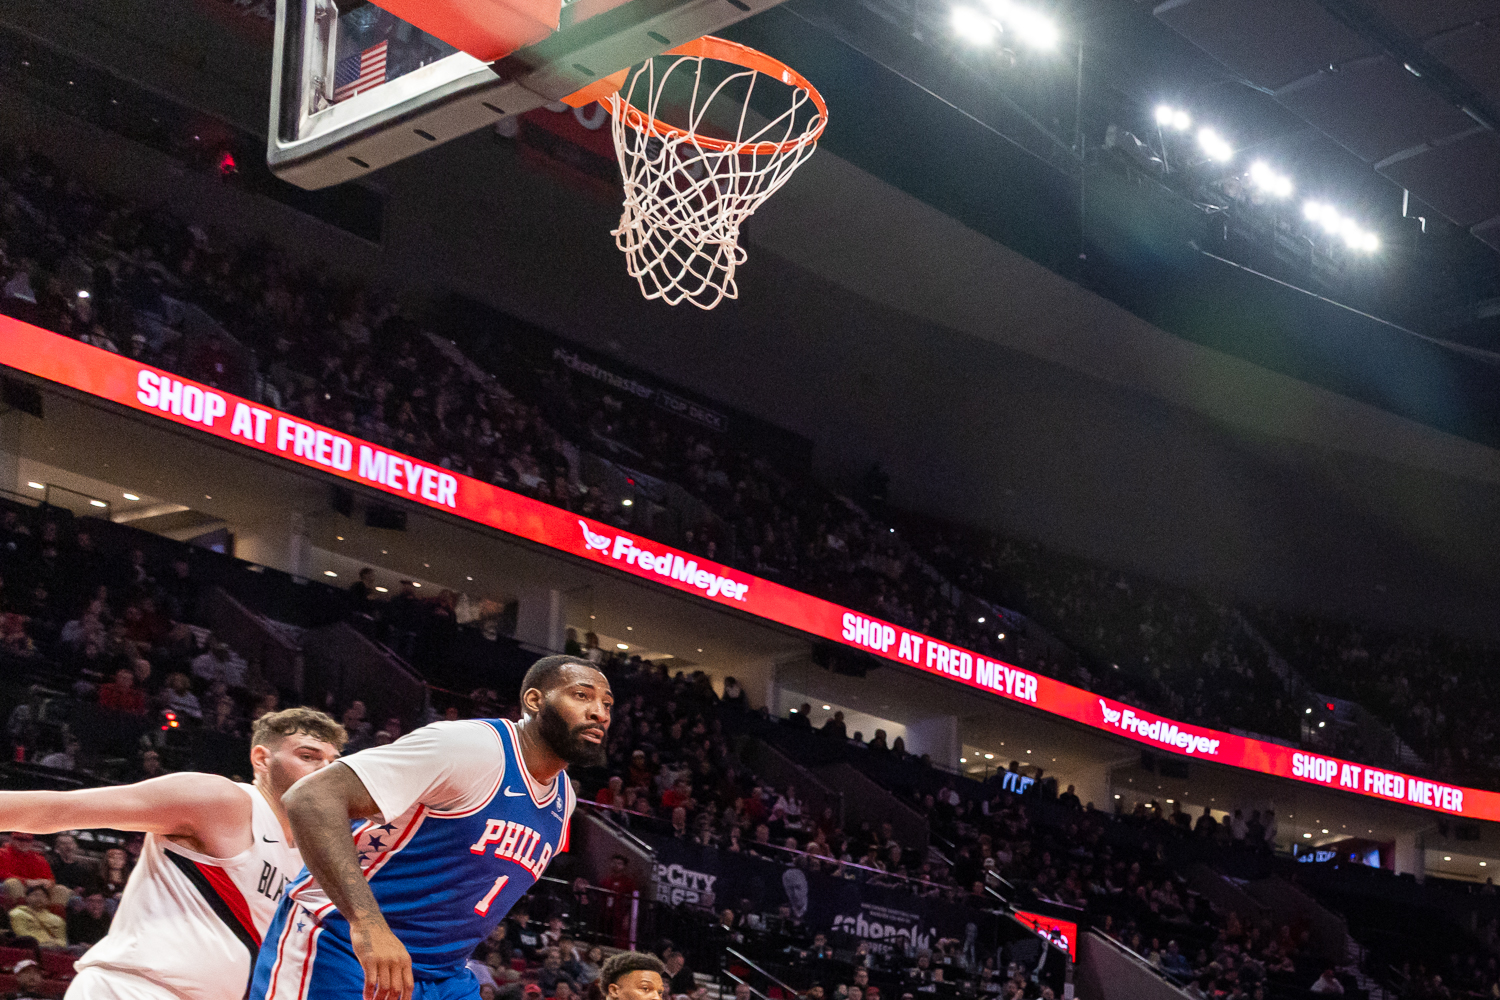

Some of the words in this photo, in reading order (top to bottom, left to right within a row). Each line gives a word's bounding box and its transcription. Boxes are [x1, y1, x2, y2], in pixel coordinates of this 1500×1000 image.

[137, 369, 226, 426] SHOP
[230, 402, 272, 444] AT
[276, 416, 352, 472] FRED
[358, 445, 457, 508] MEYER
[842, 612, 896, 653] SHOP
[898, 632, 924, 663] AT
[926, 640, 973, 680] FRED
[975, 657, 1038, 703] MEYER
[1292, 753, 1338, 783] SHOP
[1340, 764, 1361, 789] AT
[1364, 768, 1405, 799] FRED
[1408, 778, 1463, 813] MEYER
[470, 818, 553, 882] PHILA
[667, 864, 716, 893] CITY
[474, 875, 509, 917] 1
